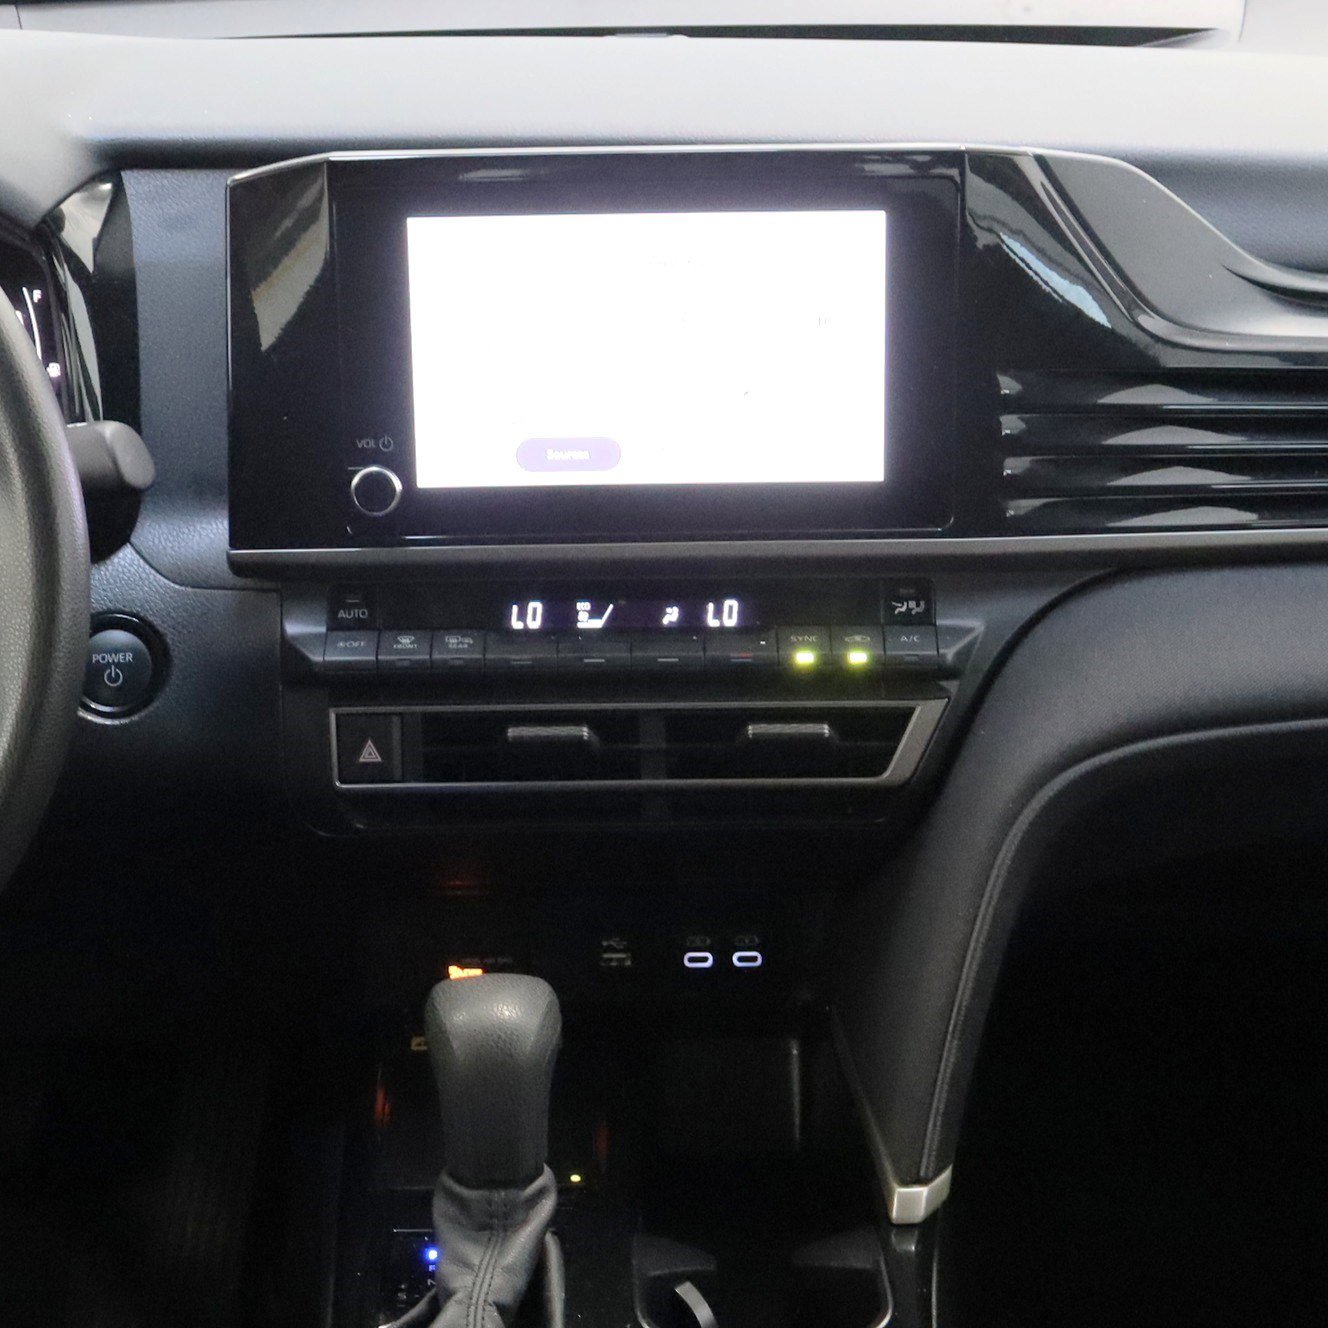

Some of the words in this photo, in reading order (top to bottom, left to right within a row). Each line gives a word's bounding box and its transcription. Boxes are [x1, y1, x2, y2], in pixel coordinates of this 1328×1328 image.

[337, 608, 369, 619] AUTO
[790, 634, 819, 642] SYNC
[900, 634, 920, 643] A/C
[91, 652, 134, 664] POWER
